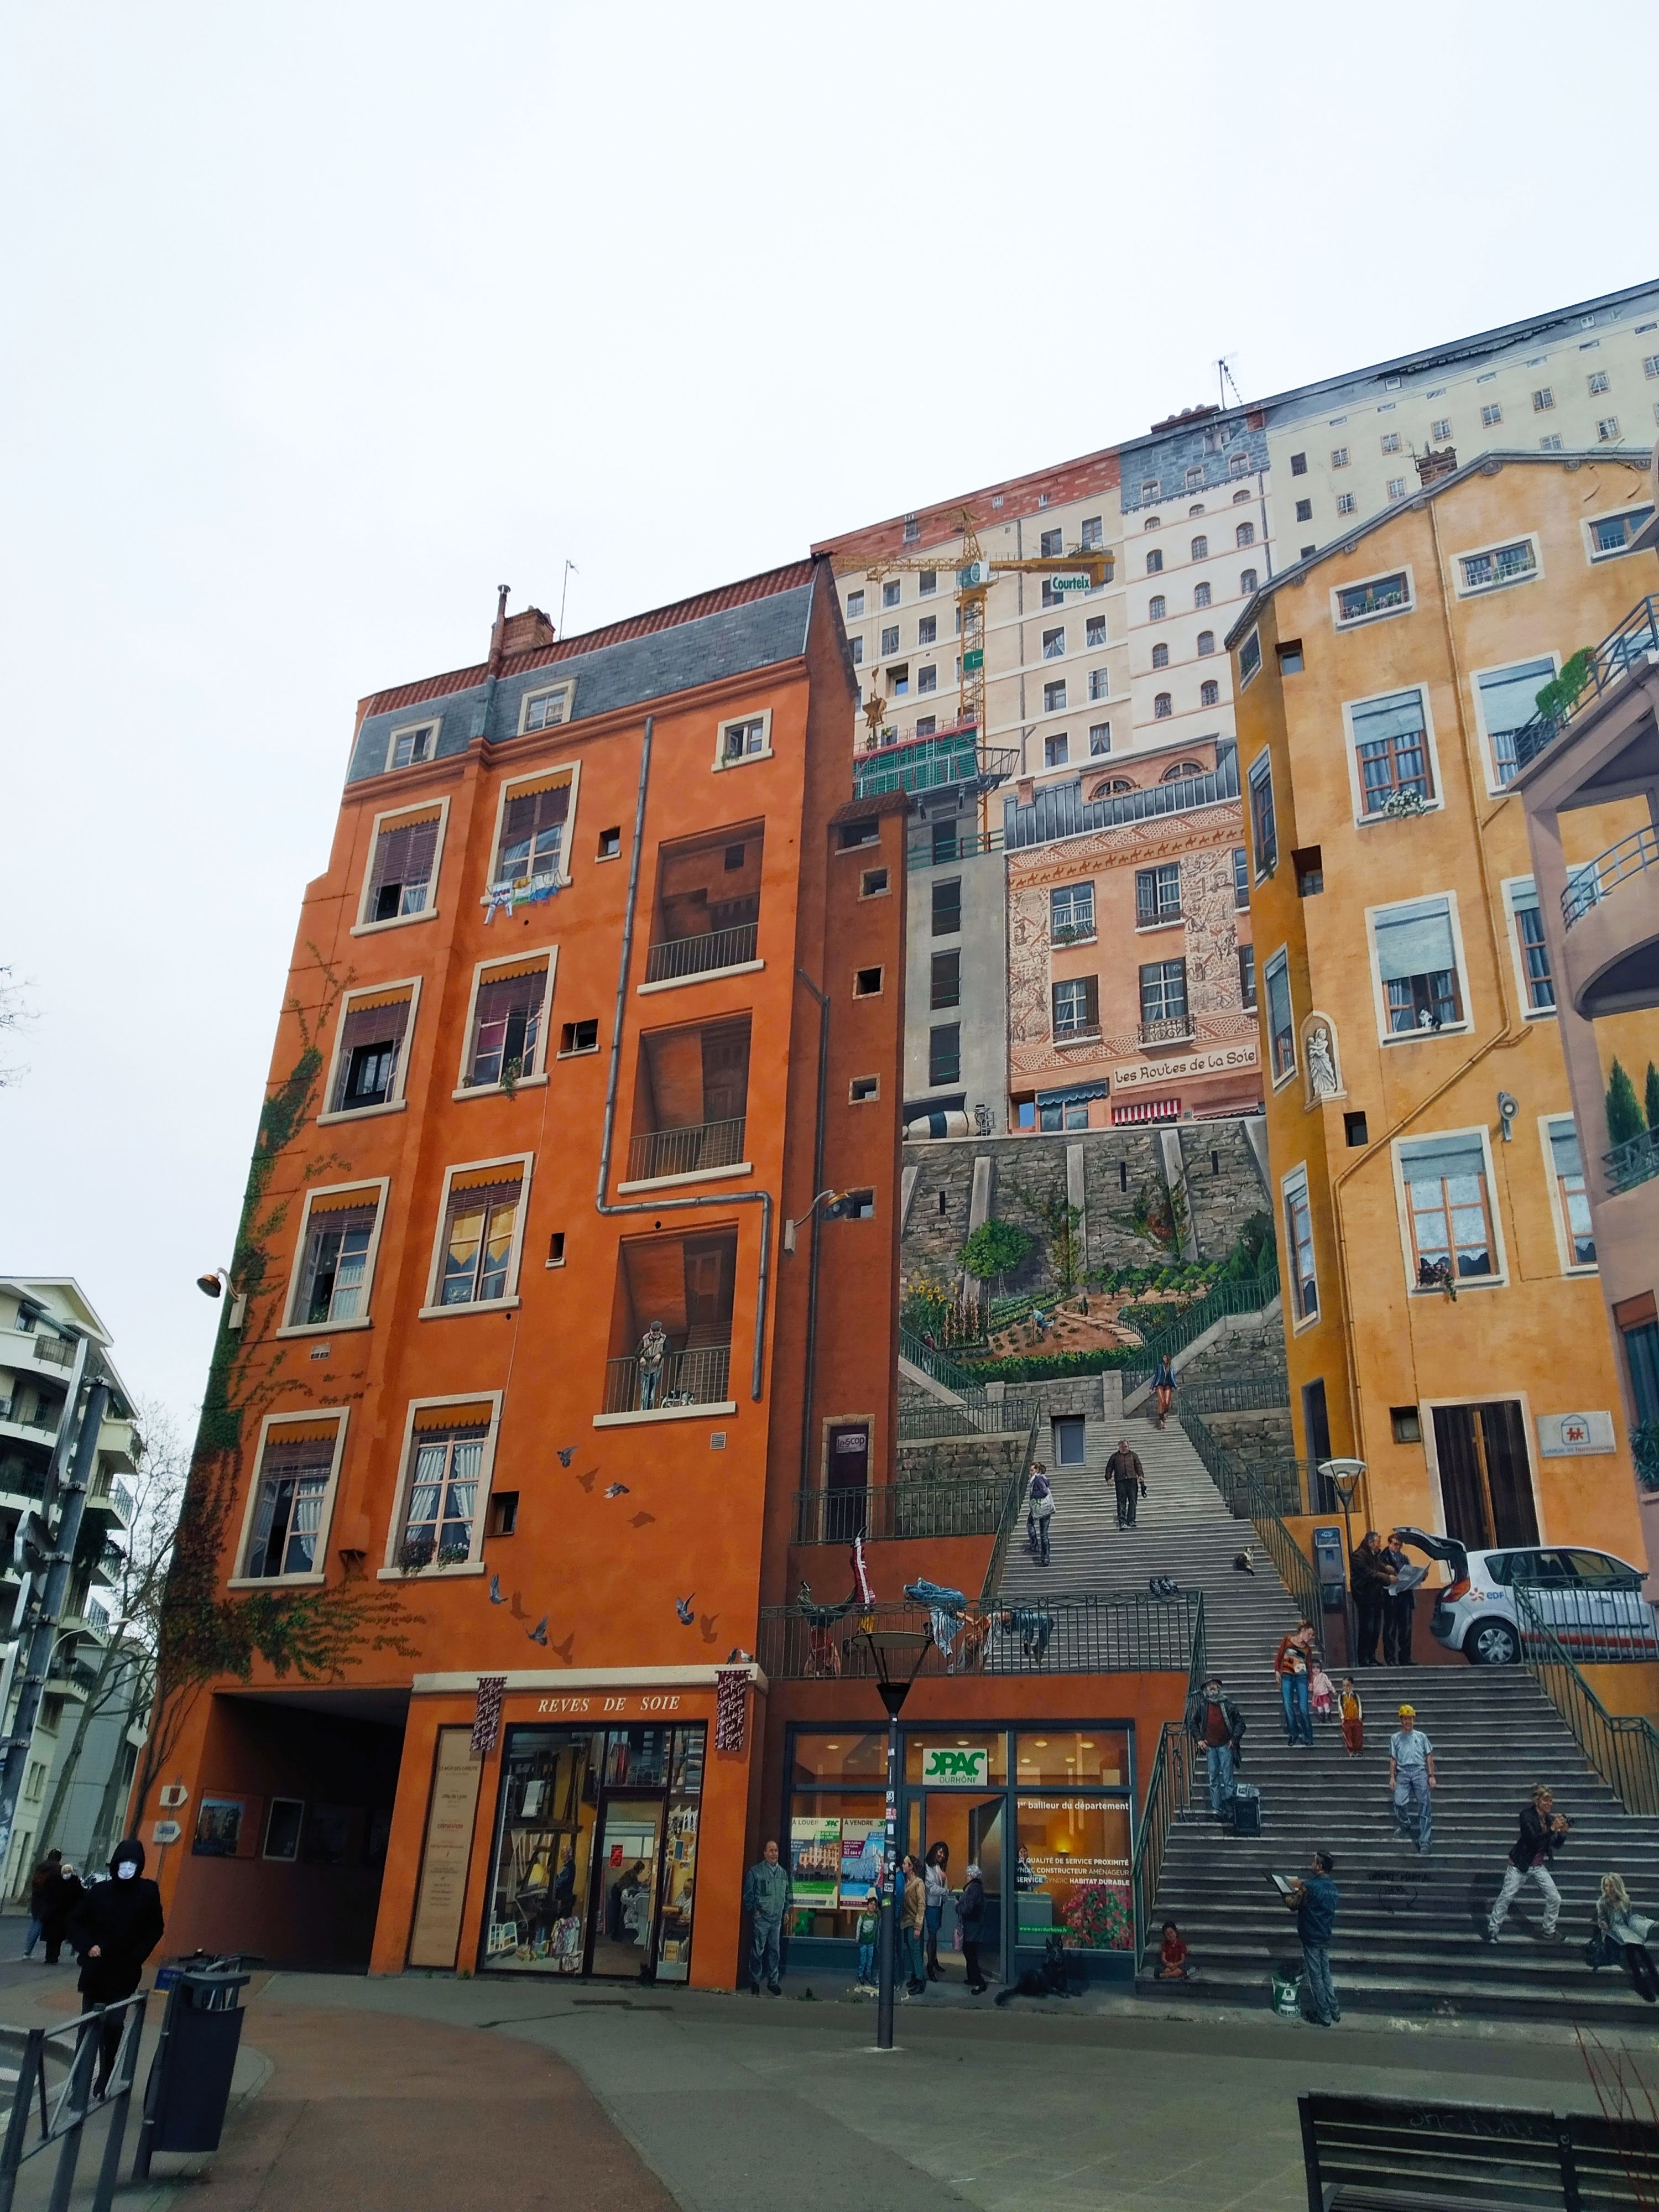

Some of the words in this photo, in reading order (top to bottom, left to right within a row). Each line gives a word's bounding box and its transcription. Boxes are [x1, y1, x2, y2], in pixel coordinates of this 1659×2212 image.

[1052, 575, 1089, 590] Courteix
[1115, 1071, 1137, 1084] Les
[1140, 1063, 1187, 1080] Routes
[1190, 1058, 1206, 1071] de
[1227, 1049, 1255, 1065] Soie
[538, 1698, 590, 1713] REVES
[603, 1697, 627, 1712] DE
[640, 1696, 681, 1711] SOIE
[1074, 1801, 1129, 1811] département
